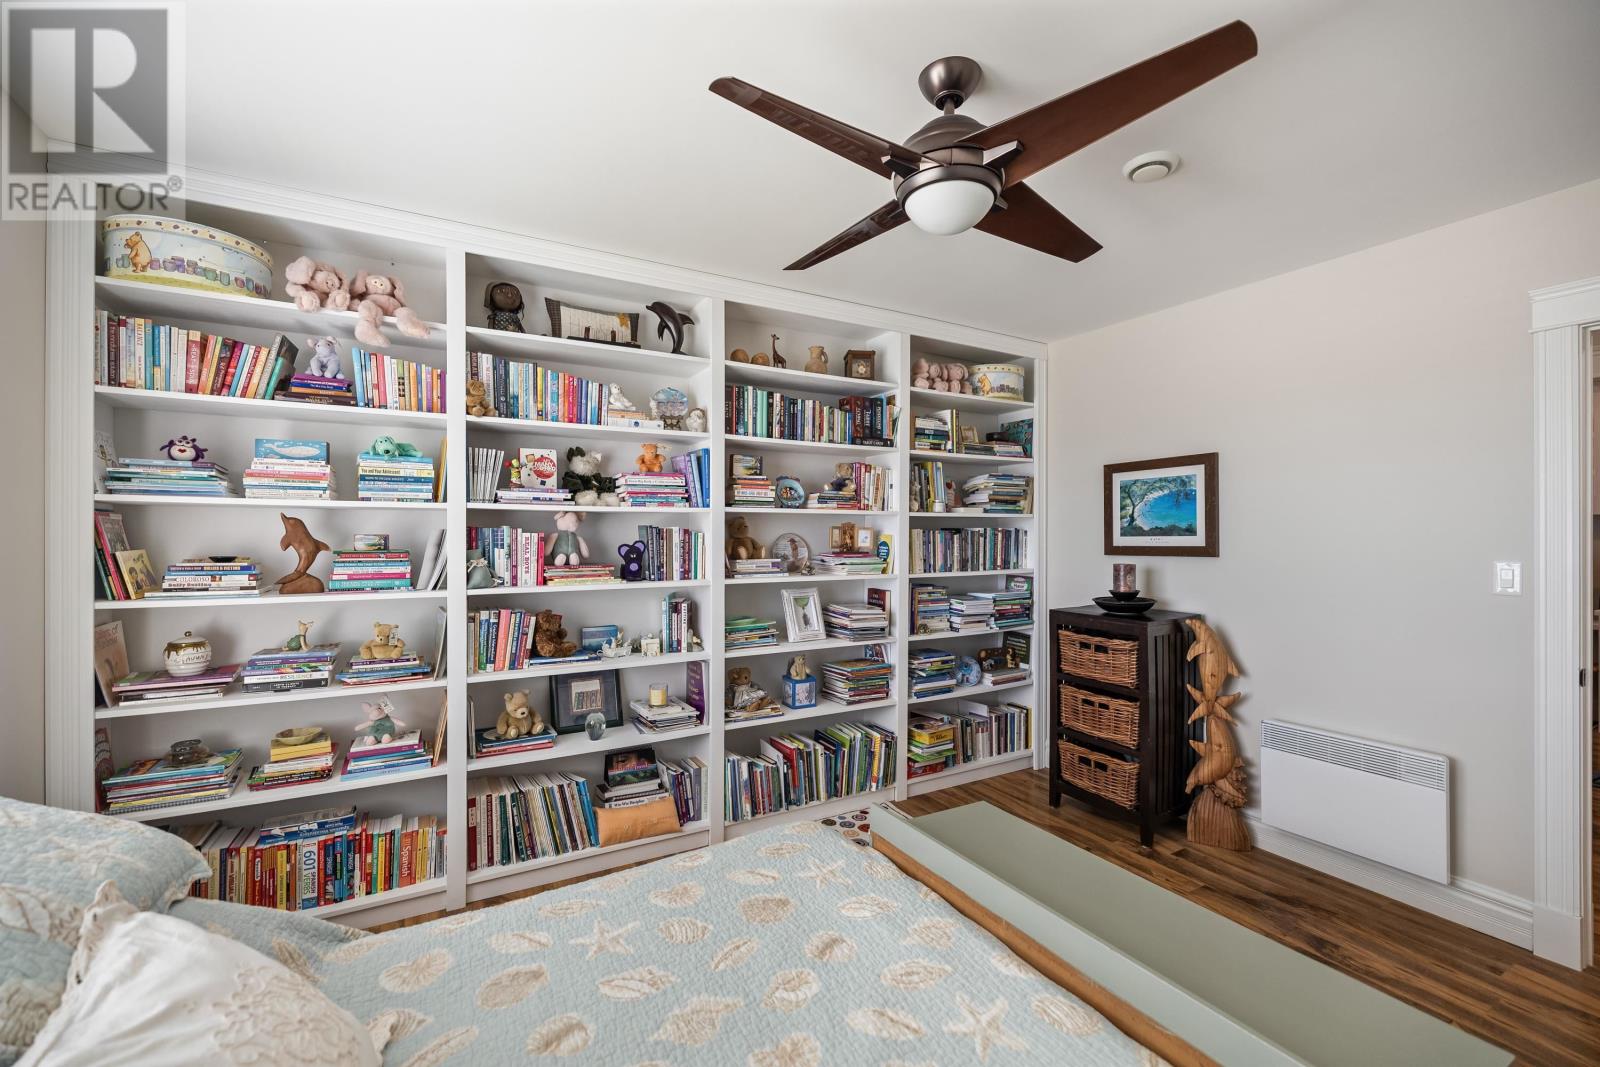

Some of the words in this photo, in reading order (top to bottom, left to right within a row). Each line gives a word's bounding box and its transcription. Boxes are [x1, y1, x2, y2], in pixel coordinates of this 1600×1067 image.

[303, 850, 316, 870] 601
[401, 845, 411, 877] Spanish
[303, 872, 311, 895] VERBS
